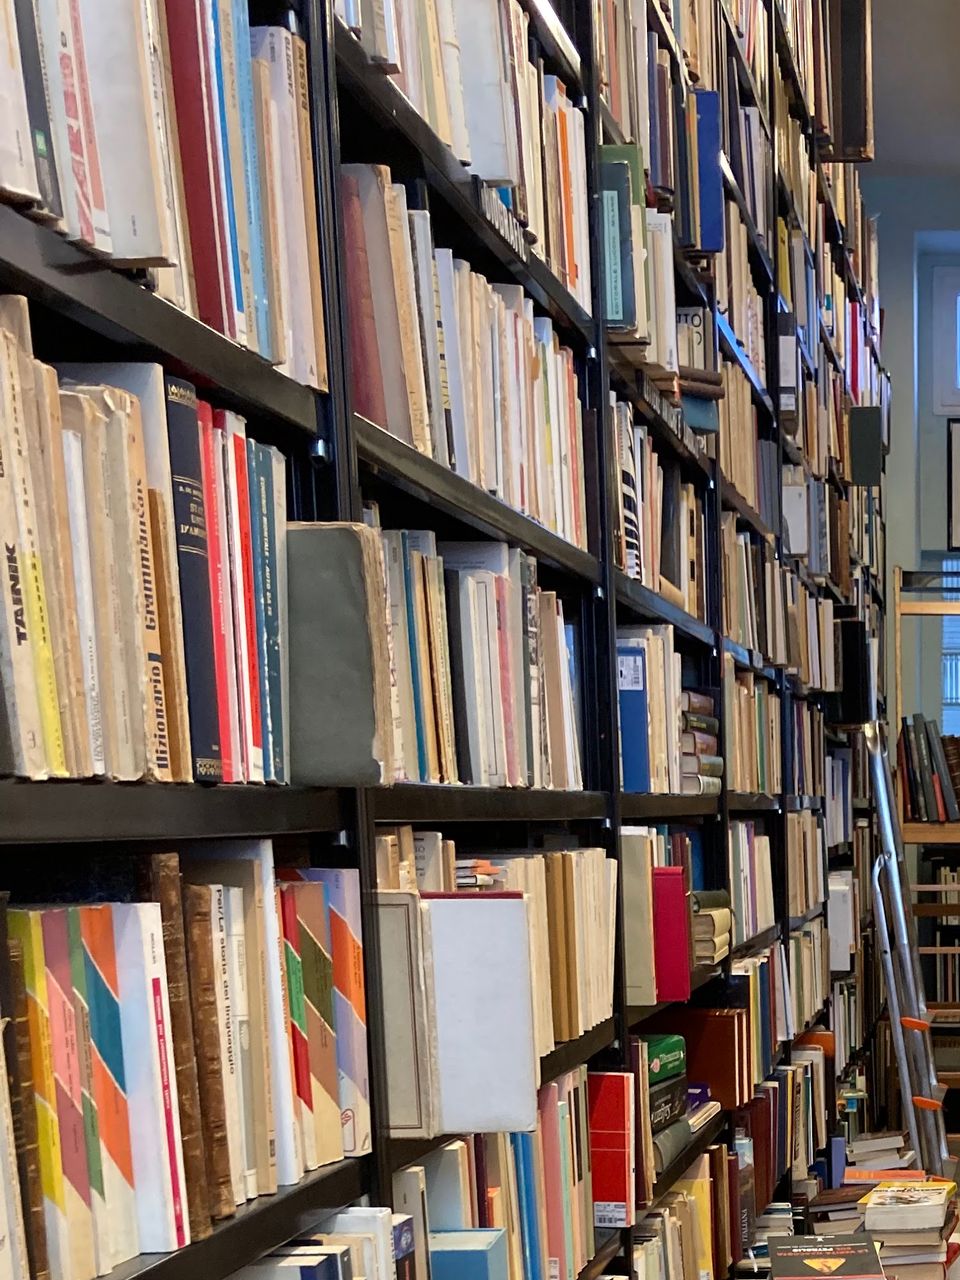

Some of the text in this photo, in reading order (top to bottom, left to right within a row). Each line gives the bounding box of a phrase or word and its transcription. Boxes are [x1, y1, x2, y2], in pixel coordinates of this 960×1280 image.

[298, 46, 309, 111] BASSANI
[259, 476, 268, 515] EUGENIO
[262, 516, 270, 557] MONTALE
[8, 542, 29, 646] TAINIK
[215, 888, 236, 1076] Pei/La storia del linguaggio
